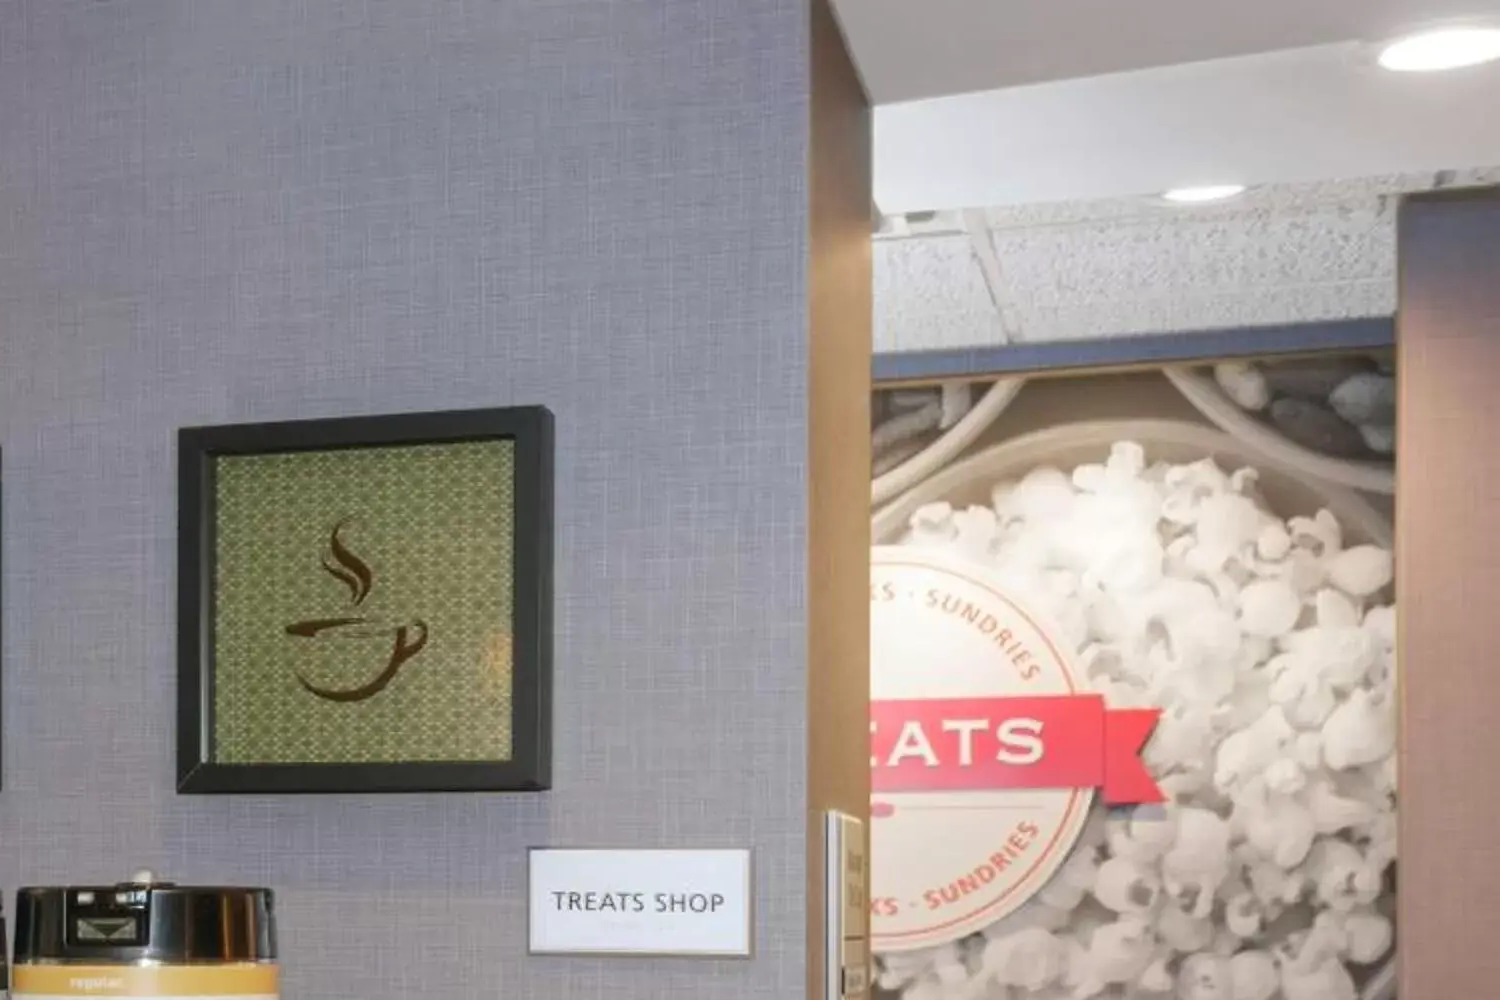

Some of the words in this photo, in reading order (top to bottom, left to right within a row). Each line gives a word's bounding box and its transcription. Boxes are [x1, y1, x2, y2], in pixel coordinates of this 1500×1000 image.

[925, 588, 1041, 681] SUNDRIES
[551, 890, 645, 913] TREATS
[653, 892, 725, 914] SHOP
[923, 820, 1040, 911] SUNDRIES
